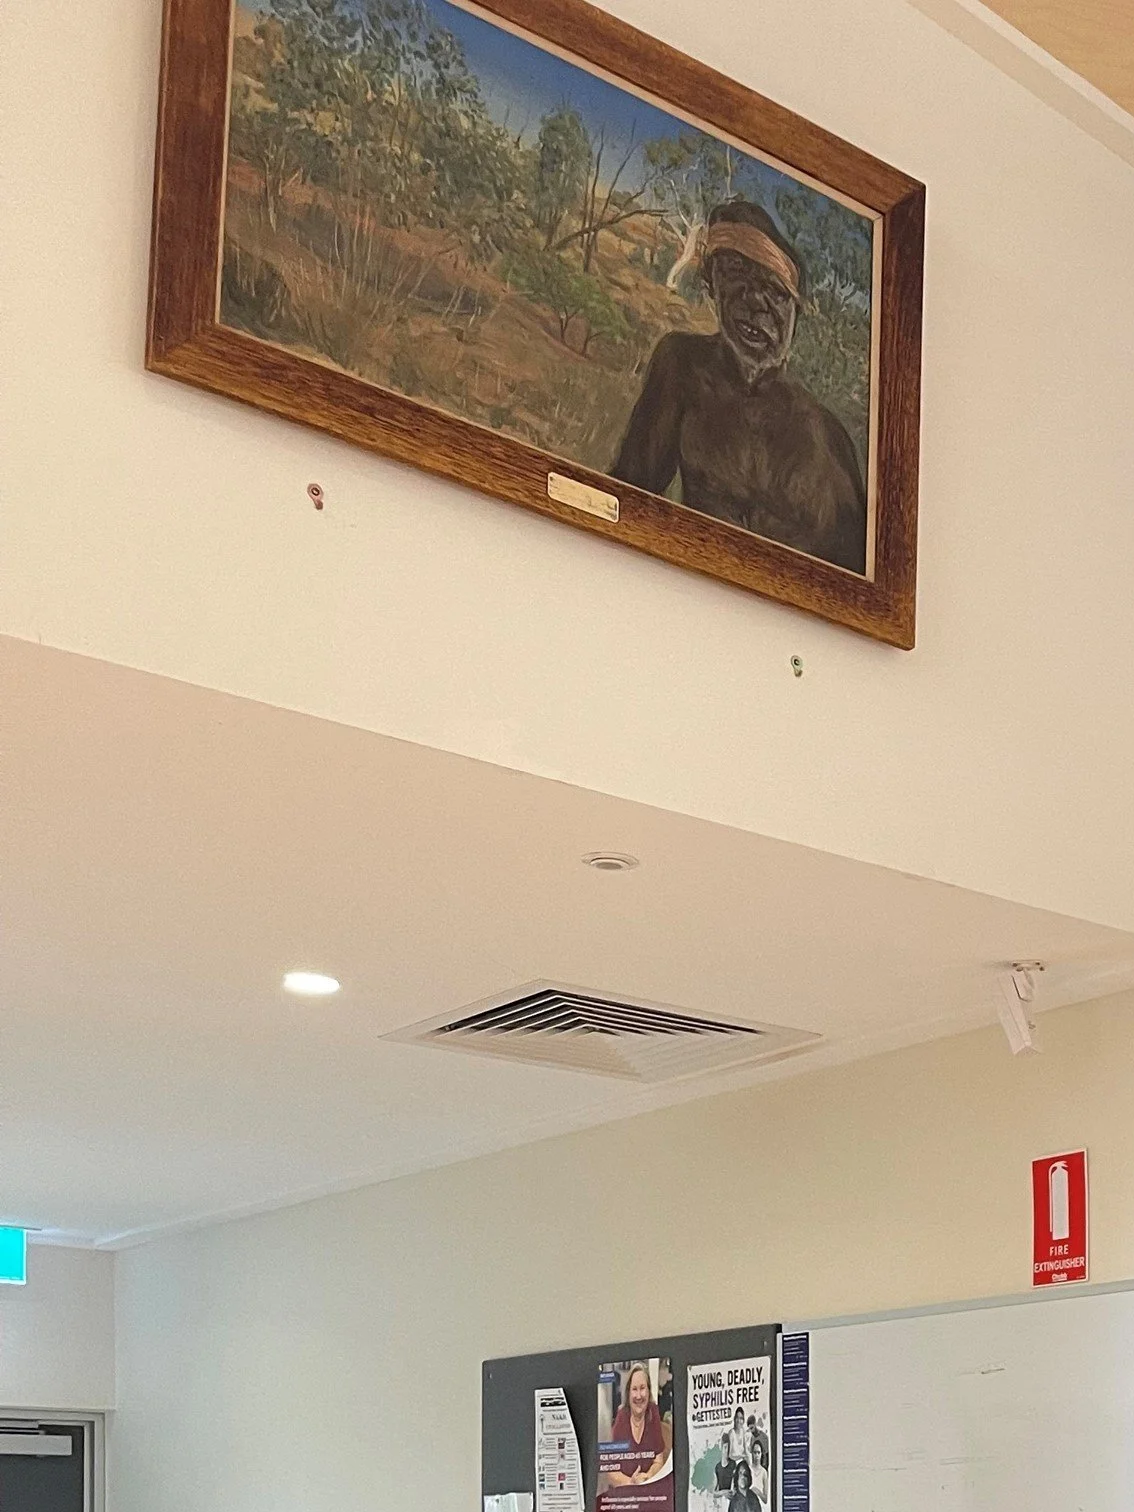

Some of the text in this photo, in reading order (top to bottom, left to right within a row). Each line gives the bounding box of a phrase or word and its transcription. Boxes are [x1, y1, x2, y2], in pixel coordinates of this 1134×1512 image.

[1049, 1244, 1069, 1257] FIRE
[1034, 1256, 1085, 1273] EXTINGUISHER
[692, 1366, 765, 1391] YOUNG, DEADLY,
[692, 1385, 760, 1409] SYPHILIS FREE
